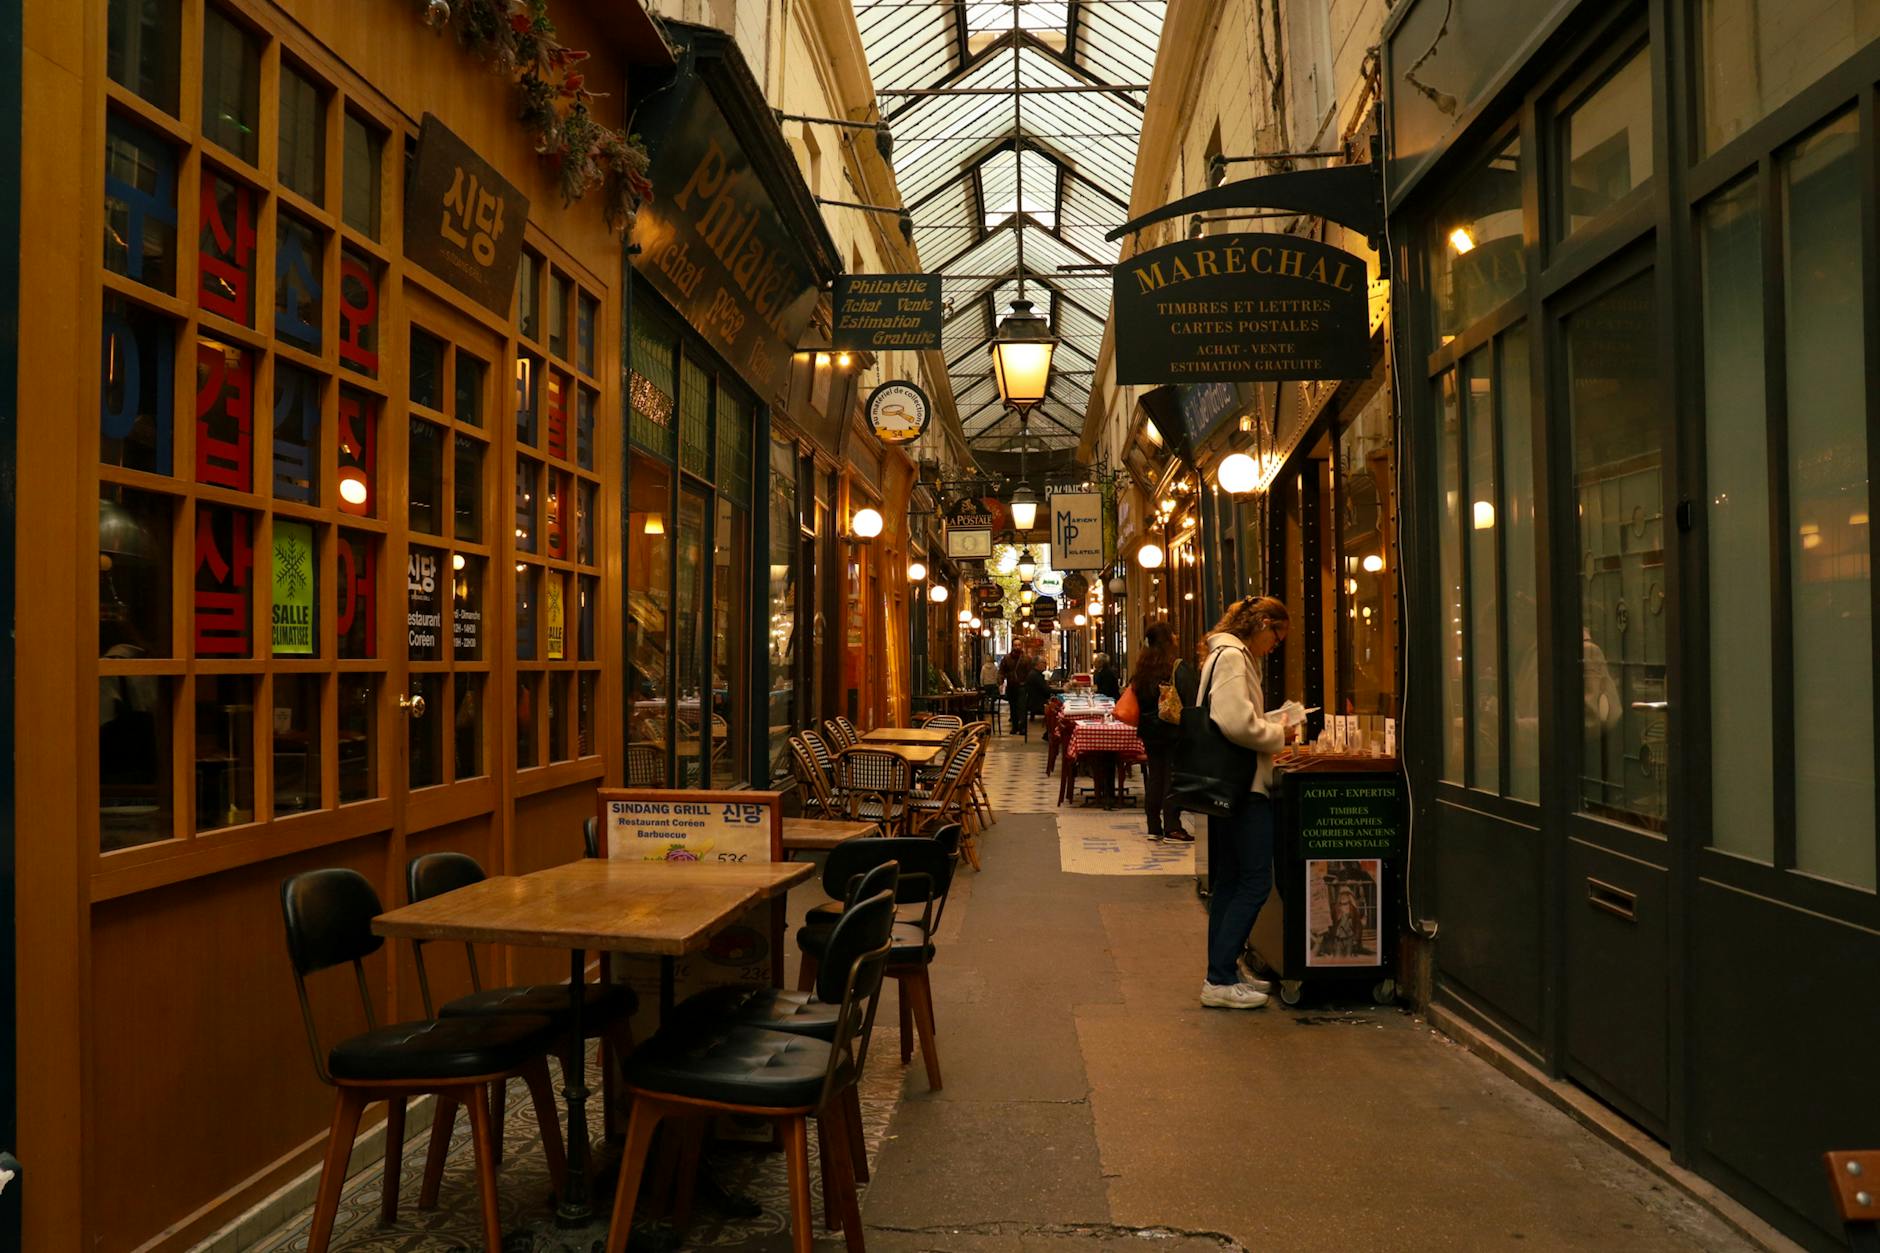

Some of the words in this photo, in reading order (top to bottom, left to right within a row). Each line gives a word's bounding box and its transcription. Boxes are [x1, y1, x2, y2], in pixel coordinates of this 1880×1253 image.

[440, 166, 505, 268] 신당
[1132, 239, 1354, 295] MARÉCHAL
[847, 280, 928, 294] Philatélie
[841, 299, 883, 312] Achat
[896, 298, 935, 312] Vente
[1157, 302, 1229, 316] TIMBRES
[1234, 300, 1254, 314] ET
[1258, 299, 1331, 314] LETTRES
[839, 315, 922, 329] Estimation
[1170, 320, 1233, 336] CARTES
[1239, 319, 1321, 334] POSTALES
[872, 330, 936, 345] Gratuite
[1197, 344, 1241, 356] ACHAT
[1250, 343, 1296, 355] VENTE
[1170, 361, 1251, 373] ESTIMATION
[1254, 359, 1322, 372] GRATUITE
[195, 169, 255, 656] 삼겹살
[872, 388, 893, 416] matériel
[904, 390, 923, 426] collections
[338, 255, 381, 659] 오징어
[945, 516, 956, 526] LA
[957, 515, 993, 526] POSTALE
[407, 554, 437, 593] 신당
[272, 604, 309, 624] SALLE
[408, 610, 441, 628] estaurant
[409, 630, 436, 648] Coréen
[1303, 788, 1338, 798] ACHAT
[612, 803, 670, 815] SINDANG
[673, 804, 711, 816] GRILL
[722, 803, 764, 824] 신당
[1330, 806, 1368, 816] TIMBRES
[618, 817, 670, 828] Restaurant
[1316, 817, 1382, 827] AUTOGRAPHES
[1302, 828, 1354, 838] COURRIERS
[1355, 827, 1397, 838] ANCIENS
[1308, 839, 1343, 849] CARTES
[1344, 838, 1389, 849] POSTALES
